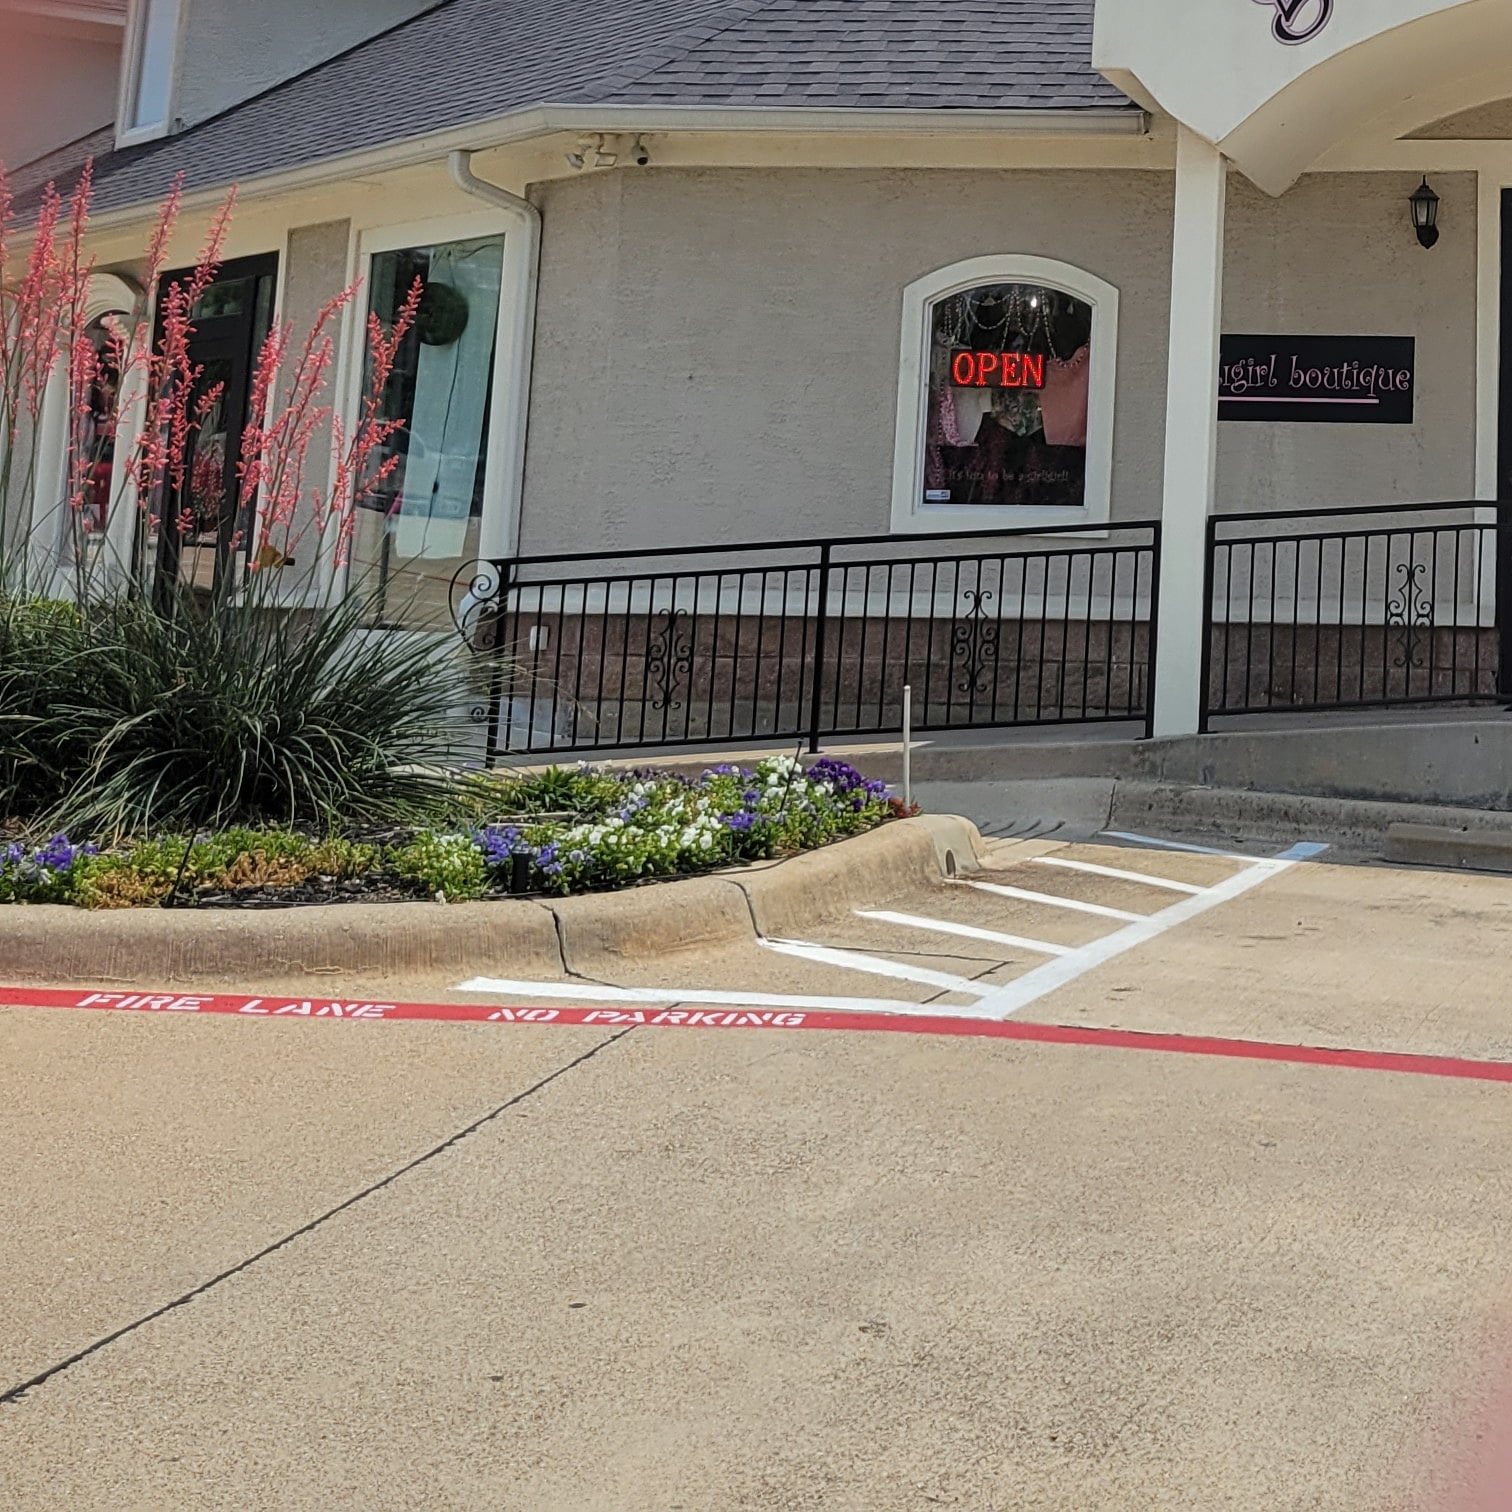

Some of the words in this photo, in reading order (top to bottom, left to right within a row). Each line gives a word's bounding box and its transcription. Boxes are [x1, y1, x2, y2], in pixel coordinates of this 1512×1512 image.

[952, 352, 1044, 387] OPEN
[1288, 355, 1411, 397] boutique
[75, 993, 214, 1011] FIRE
[239, 999, 397, 1018] LANE
[487, 1008, 560, 1022] NO
[582, 1010, 807, 1026] PARKING
